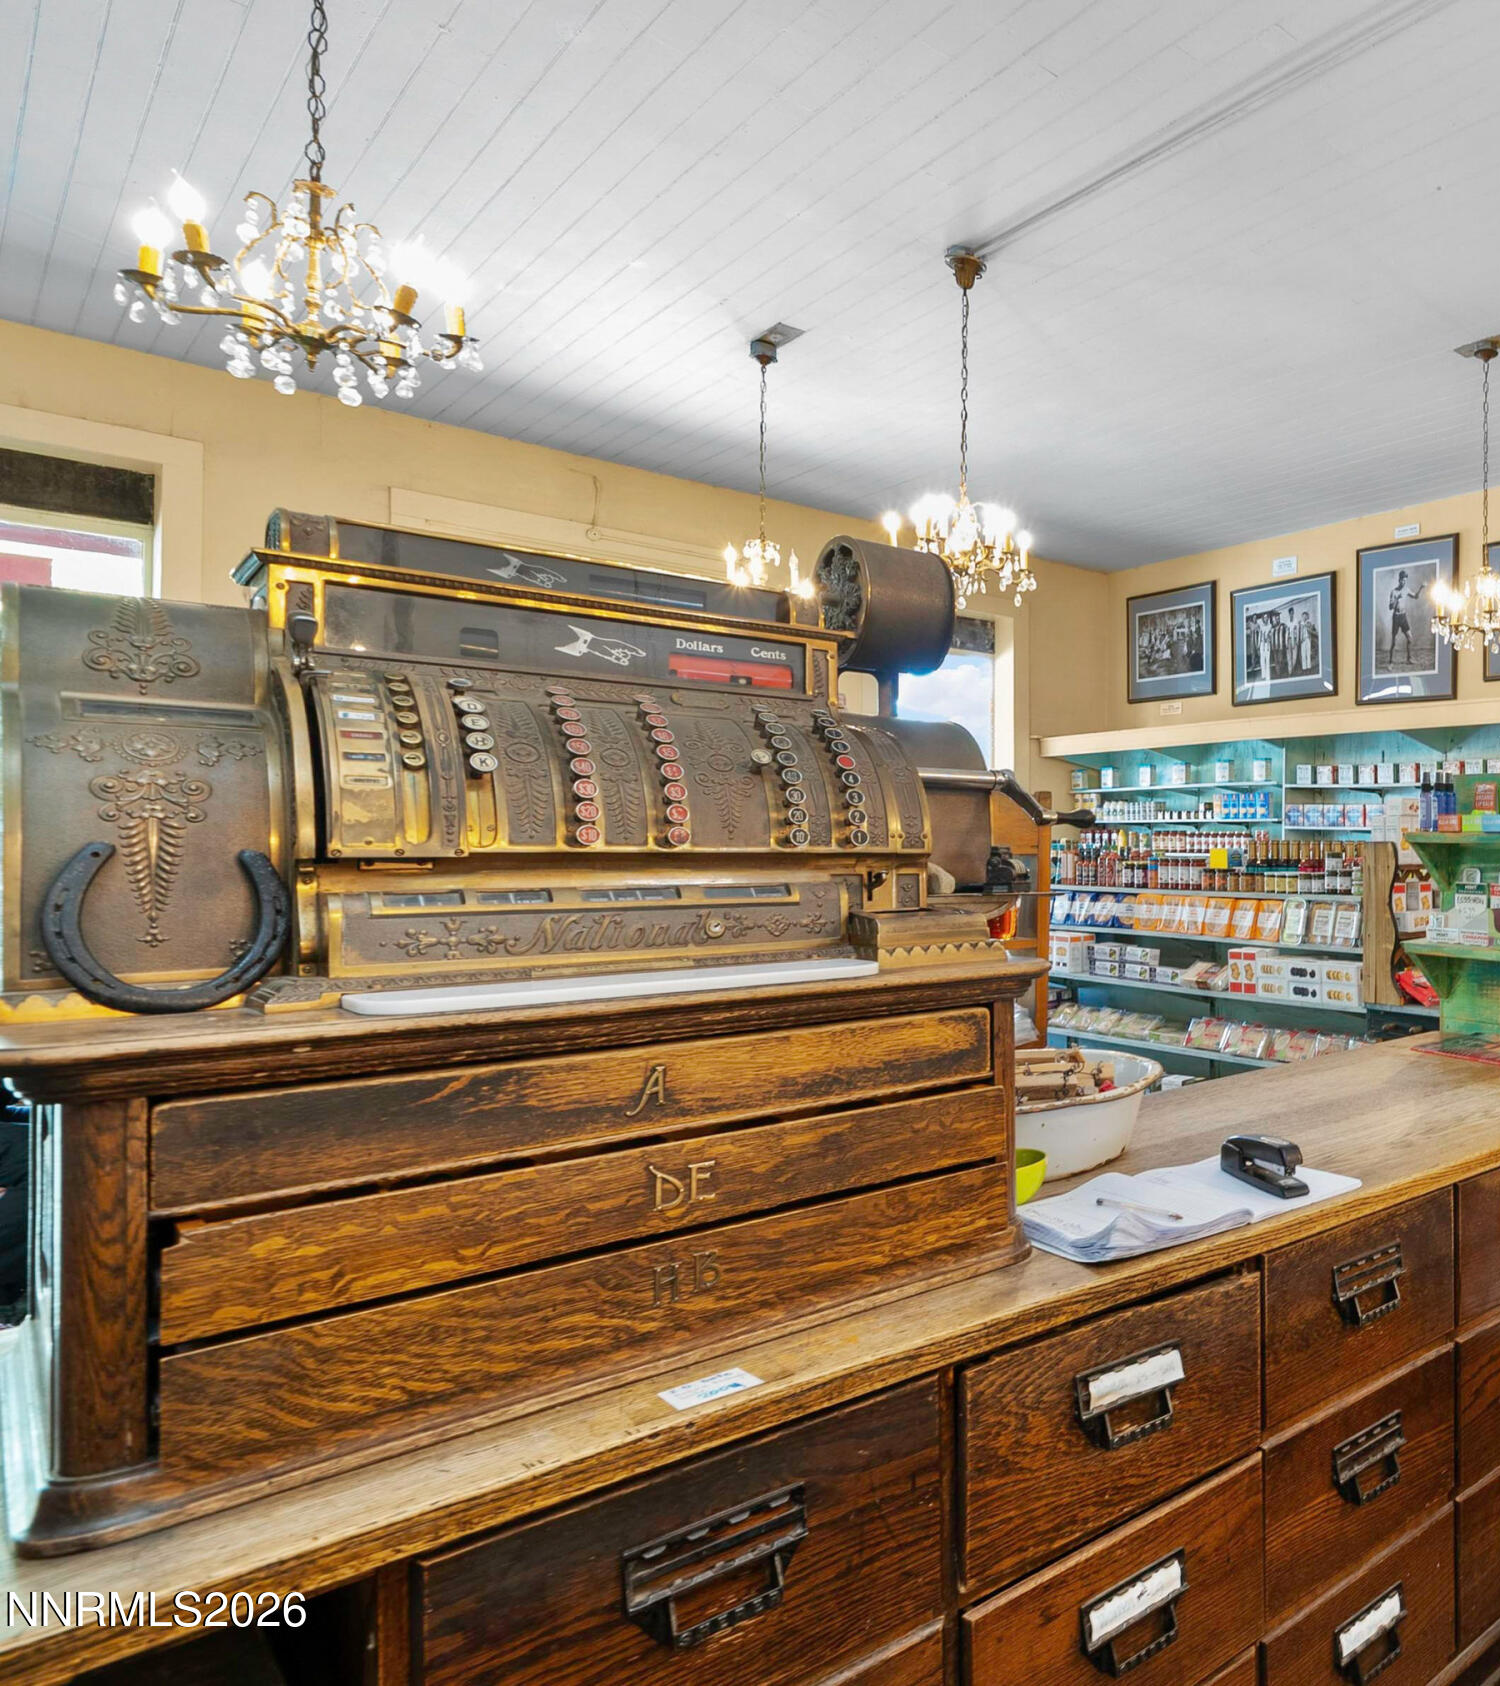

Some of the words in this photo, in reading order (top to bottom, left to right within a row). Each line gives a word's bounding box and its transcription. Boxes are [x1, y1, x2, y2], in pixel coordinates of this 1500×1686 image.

[676, 638, 724, 654] Dollars
[750, 647, 787, 661] Cents
[504, 908, 713, 956] National
[625, 1064, 666, 1117] A
